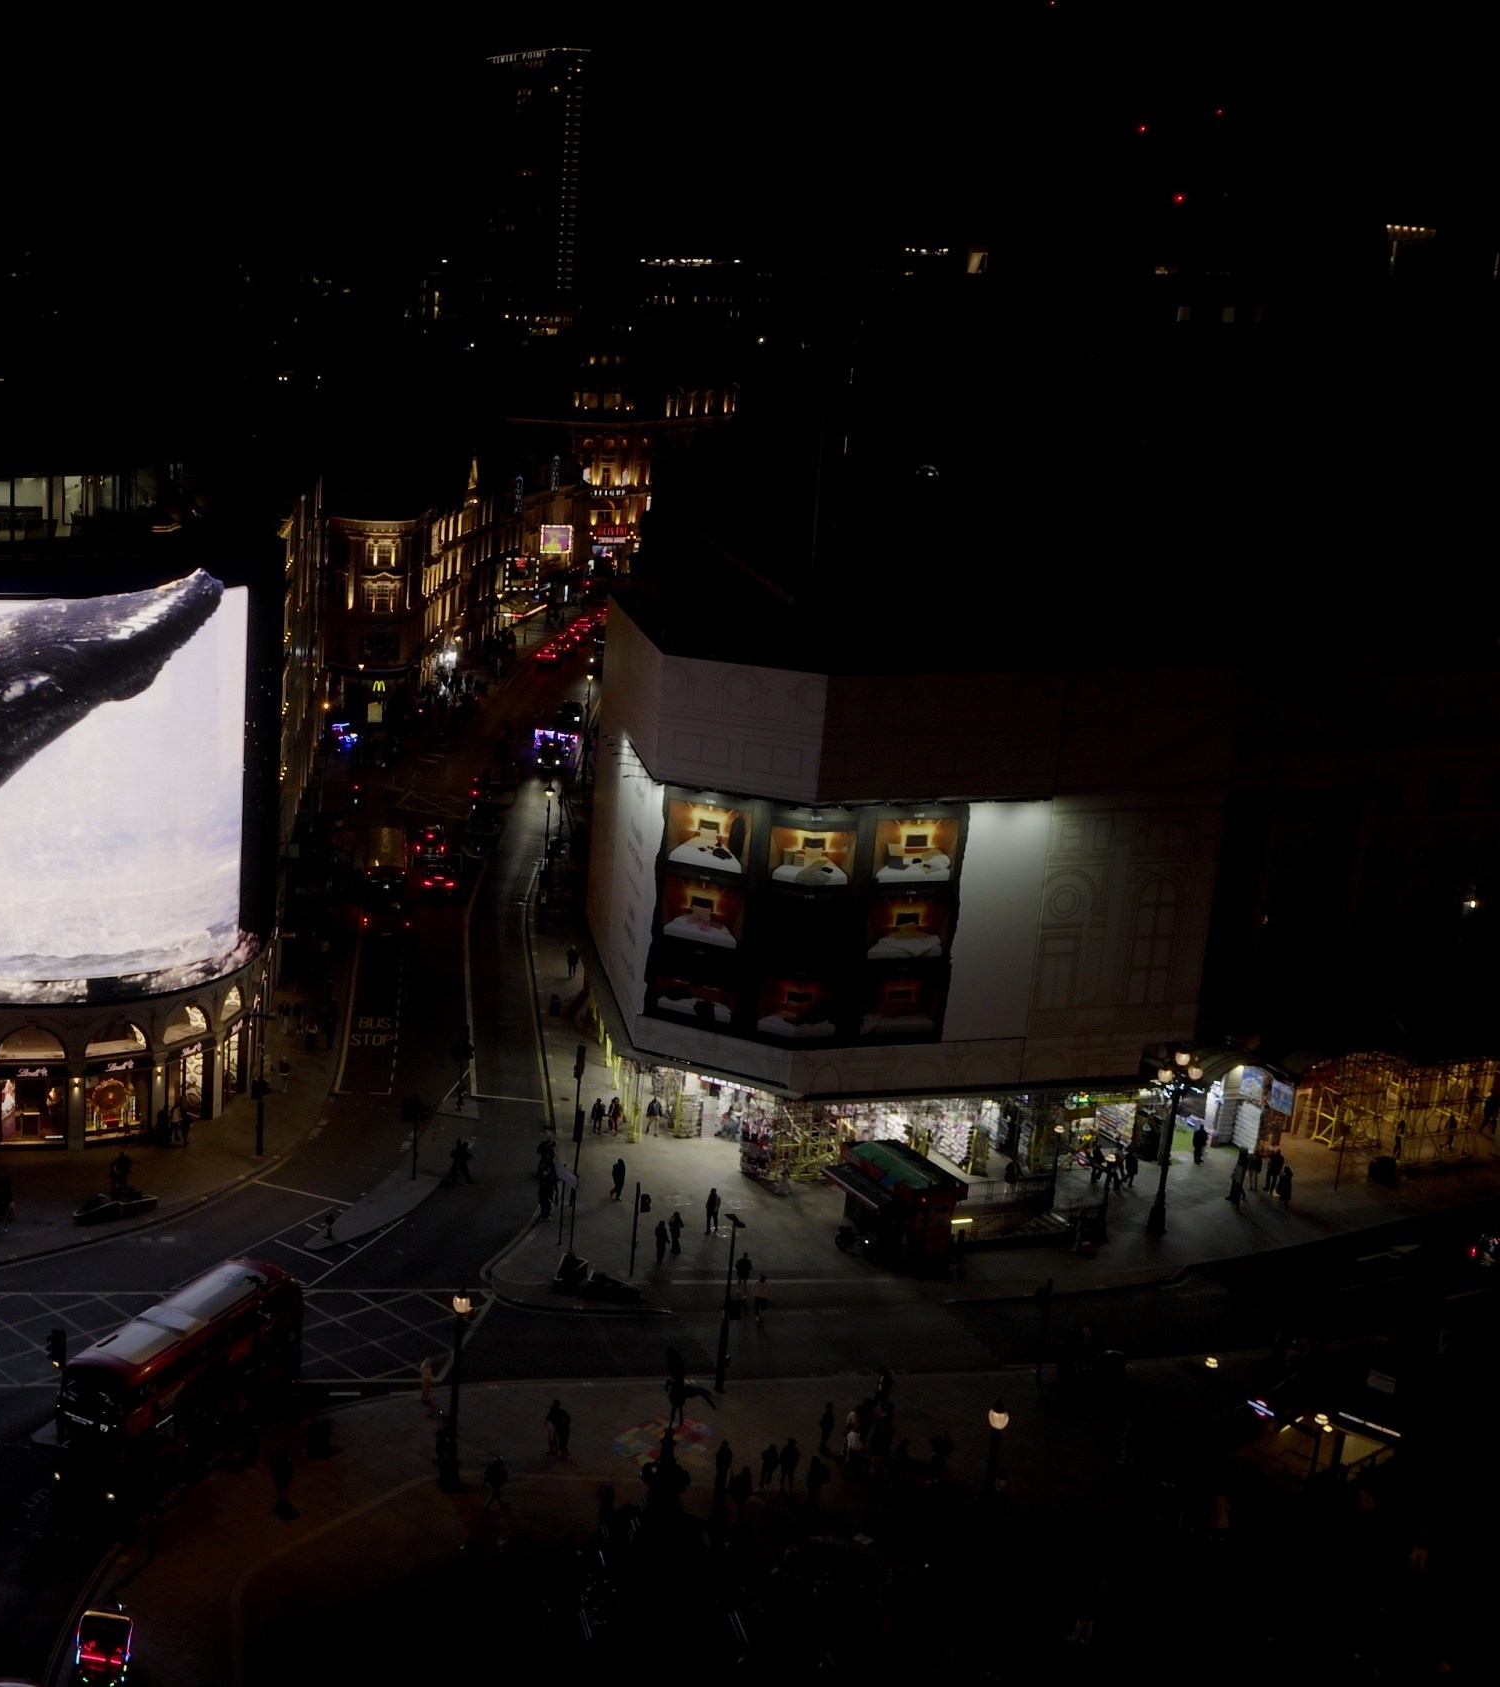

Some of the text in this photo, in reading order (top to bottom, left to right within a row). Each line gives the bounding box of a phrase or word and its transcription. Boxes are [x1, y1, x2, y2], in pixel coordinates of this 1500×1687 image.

[522, 50, 547, 61] POINT
[358, 1016, 392, 1029] BUS
[349, 1033, 394, 1046] STOP
